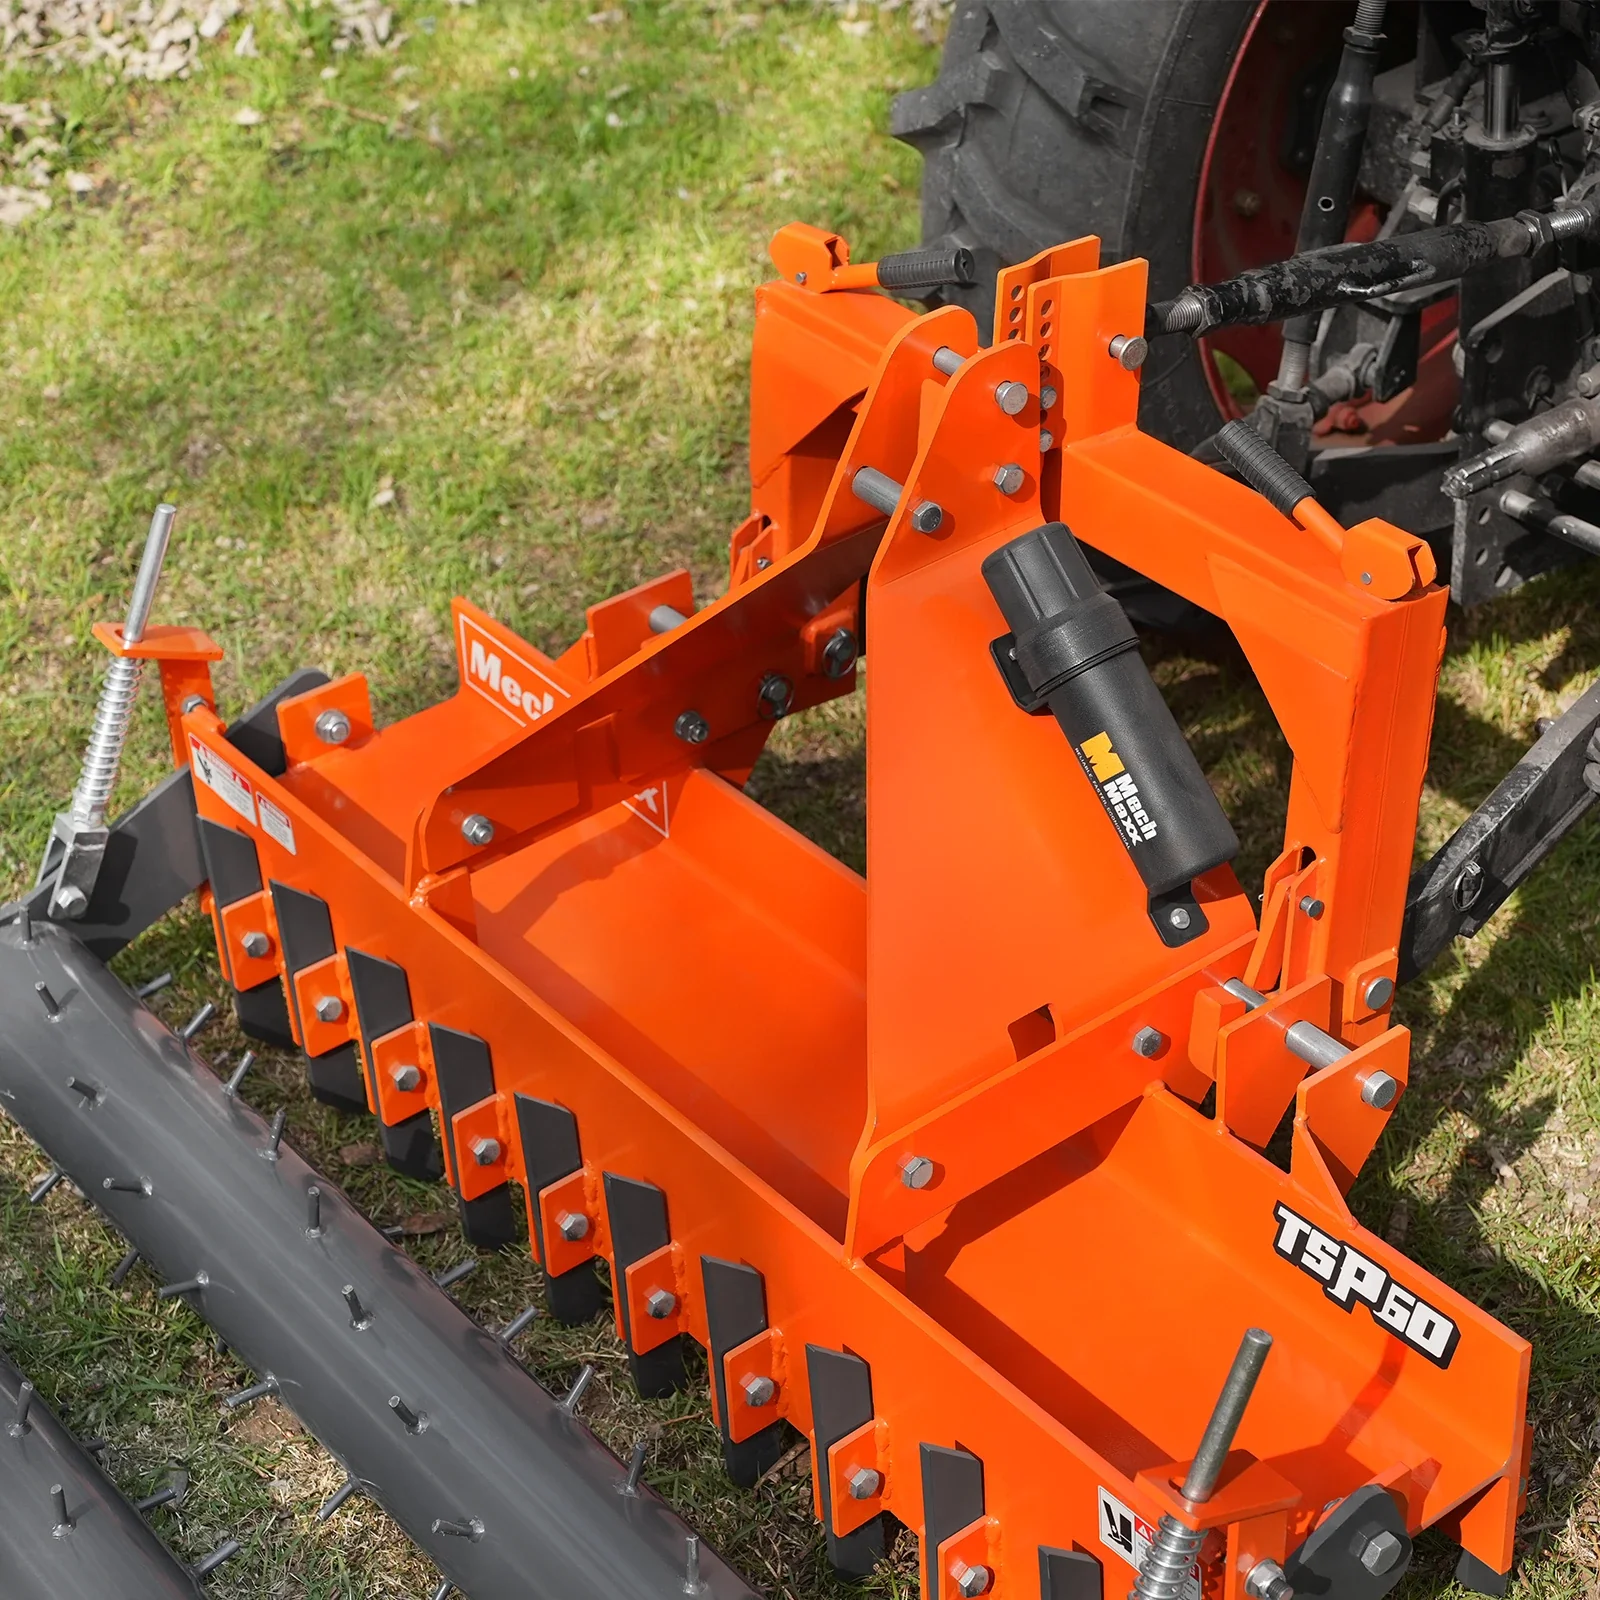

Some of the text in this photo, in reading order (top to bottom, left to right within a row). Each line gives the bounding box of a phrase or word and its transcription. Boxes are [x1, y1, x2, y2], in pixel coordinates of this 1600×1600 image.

[1103, 781, 1143, 847] Maxx
[1106, 807, 1131, 850] ECONOMICAL
[1115, 773, 1158, 841] Mech
[1275, 1204, 1457, 1364] TSP60
